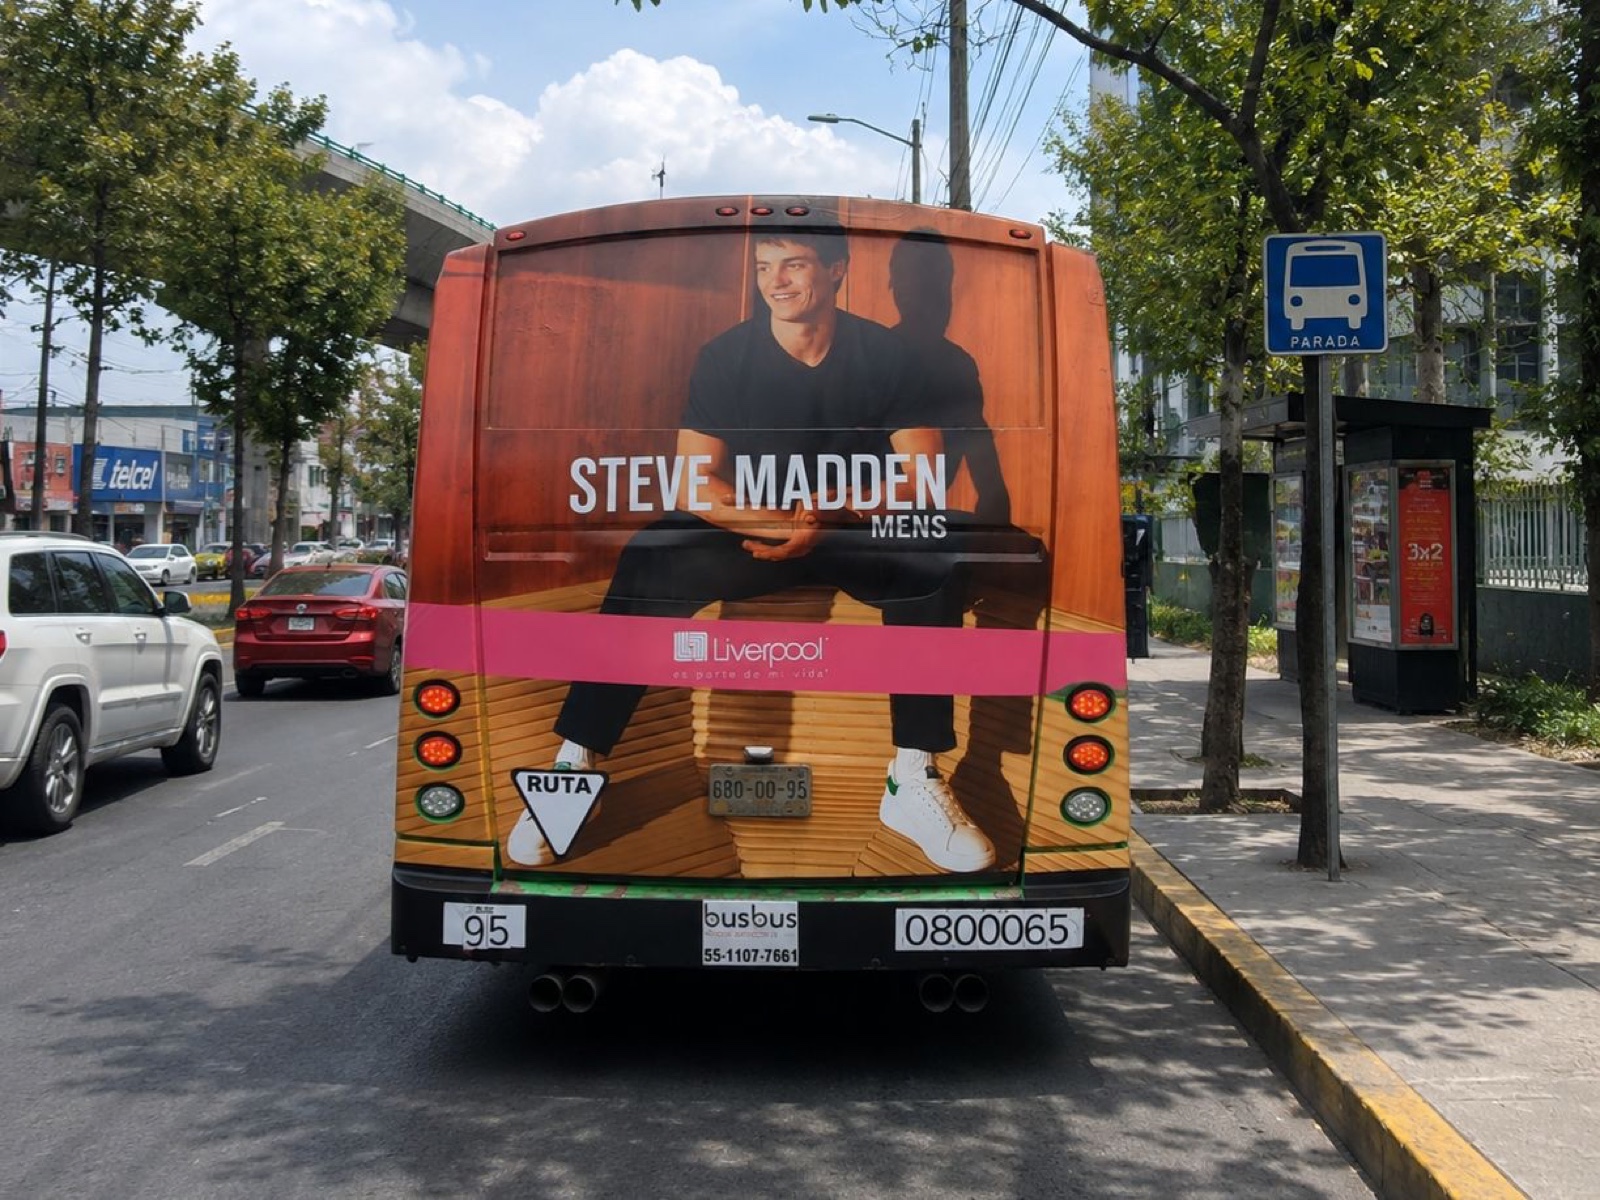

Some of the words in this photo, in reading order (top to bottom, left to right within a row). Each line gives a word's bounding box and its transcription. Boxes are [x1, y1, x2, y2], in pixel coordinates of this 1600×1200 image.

[1290, 335, 1361, 349] PARADA
[109, 459, 158, 490] telcel
[569, 455, 712, 514] STEVE
[735, 454, 946, 511] MADDEN
[871, 514, 947, 539] MENS
[1407, 543, 1444, 561] 3x2
[713, 637, 823, 668] Liverpool
[743, 670, 761, 679] de
[526, 775, 592, 795] RUTA
[713, 781, 807, 799] 680-00-95
[704, 902, 797, 928] busbus
[464, 915, 509, 946] 95
[905, 913, 1069, 946] 0800065
[704, 948, 797, 963] 55-1107-7661
